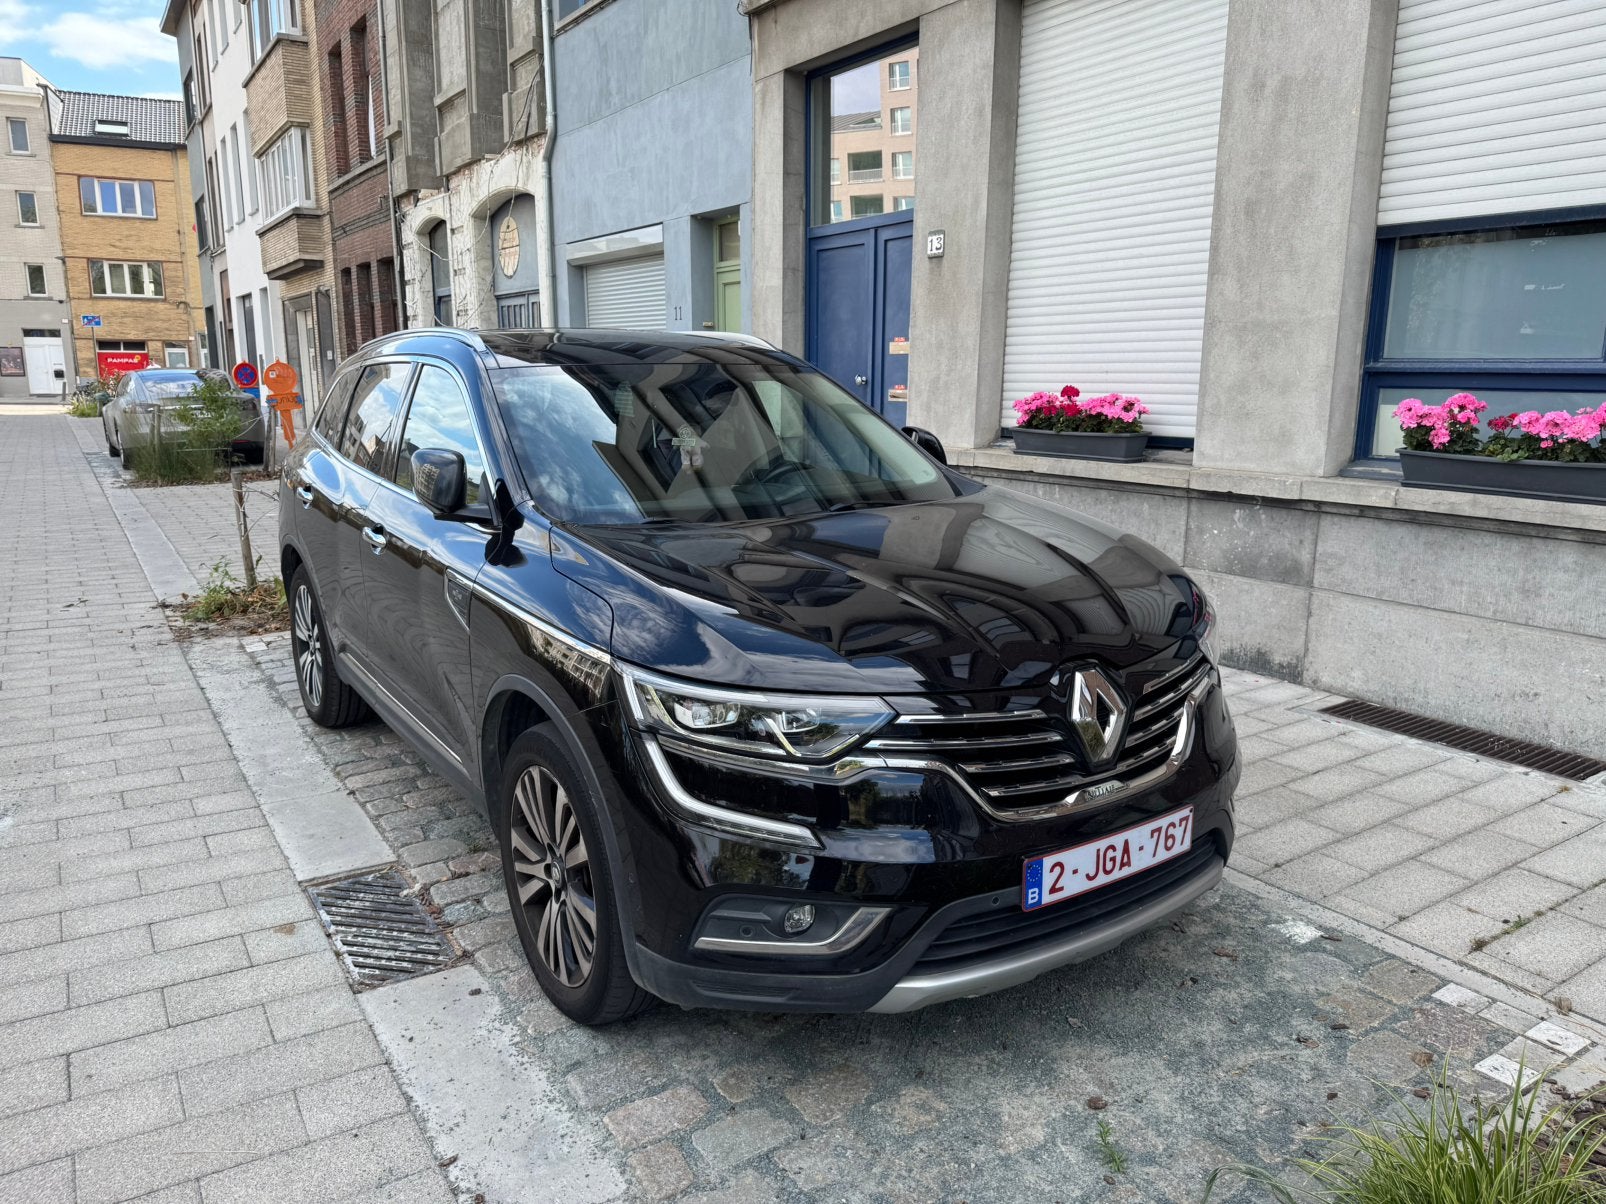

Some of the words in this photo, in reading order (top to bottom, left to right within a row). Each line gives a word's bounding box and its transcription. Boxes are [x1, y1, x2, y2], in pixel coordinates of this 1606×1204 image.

[929, 236, 943, 252] 13
[674, 305, 683, 320] 11
[1048, 814, 1190, 896] 2-JGA-767
[1027, 887, 1039, 905] B
